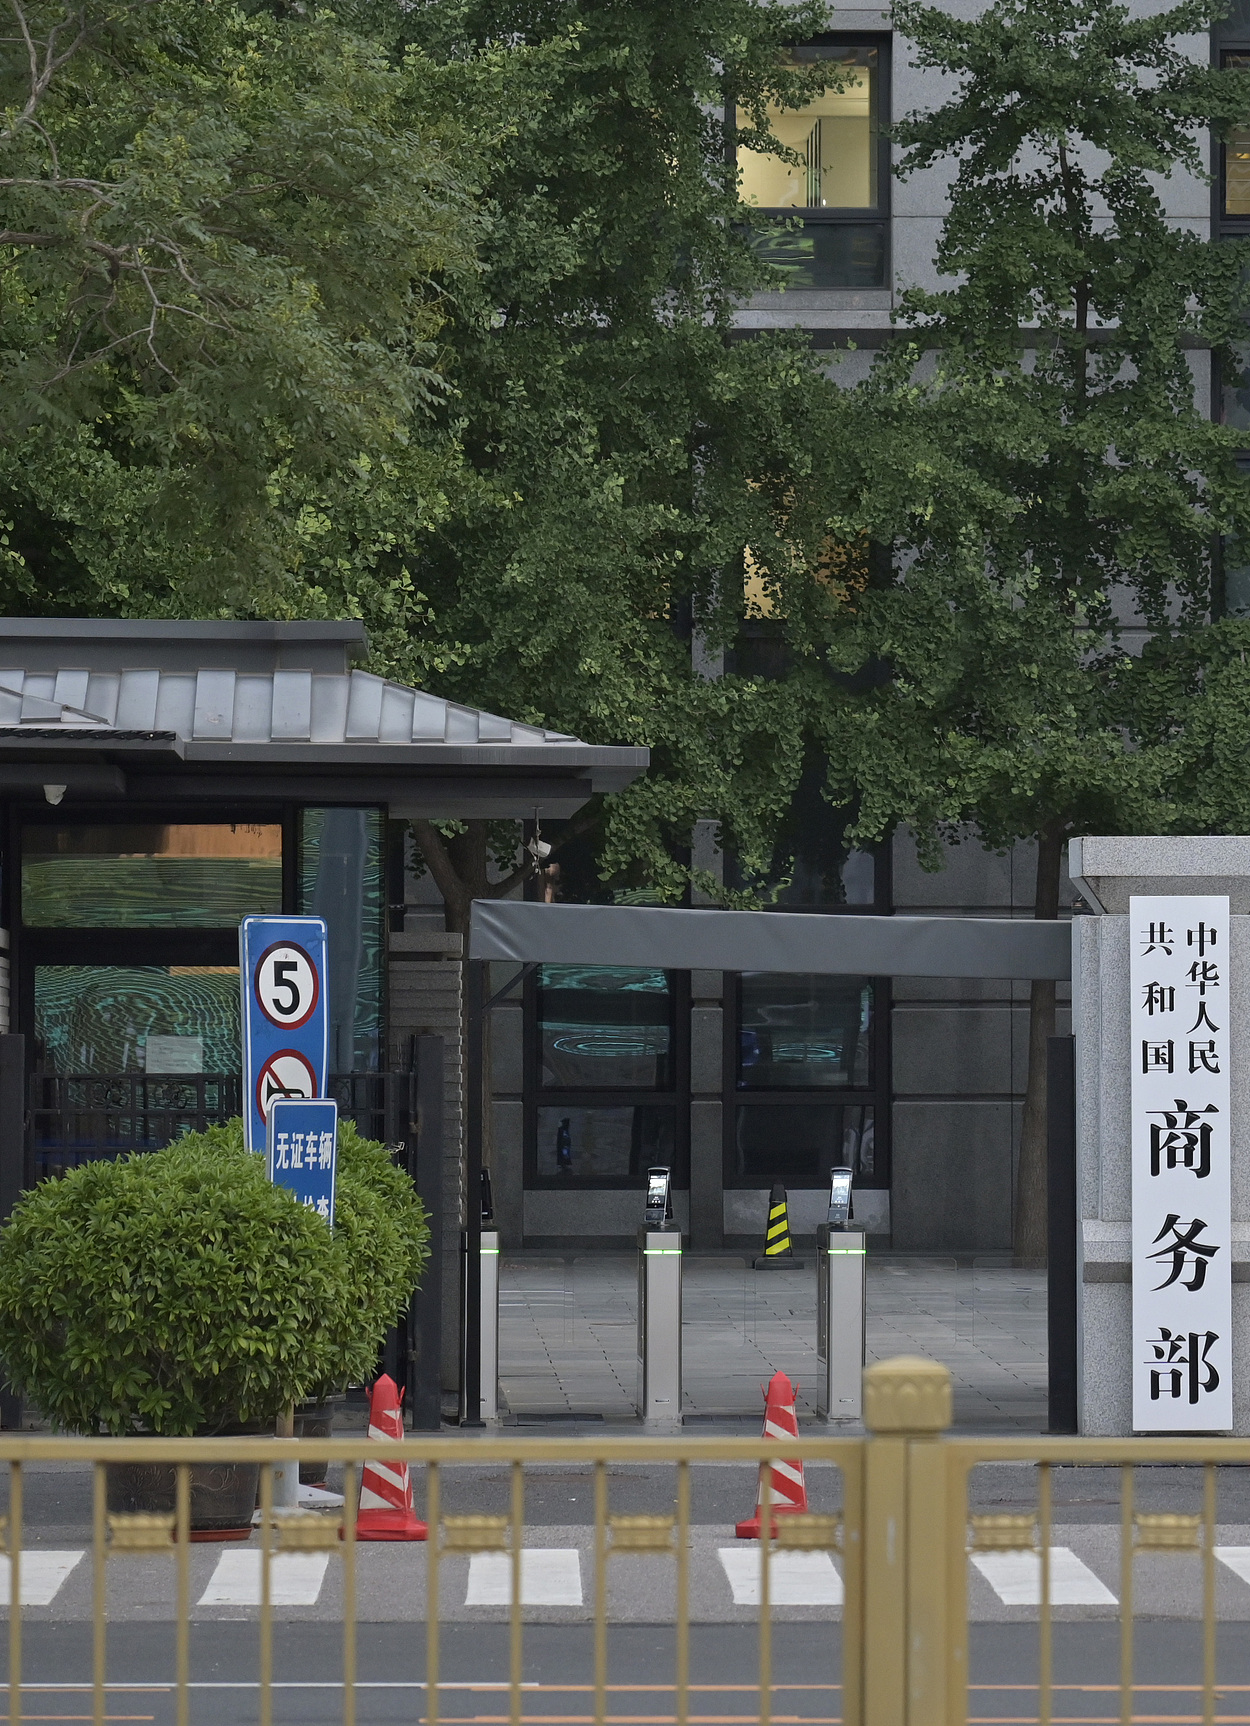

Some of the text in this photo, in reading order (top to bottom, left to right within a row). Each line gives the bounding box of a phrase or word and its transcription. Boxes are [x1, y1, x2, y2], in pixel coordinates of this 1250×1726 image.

[272, 960, 300, 1016] 5
[1140, 921, 1176, 1075] 共和国
[1185, 921, 1221, 1075] 中华人民
[276, 1130, 333, 1170] 无证车辆
[1143, 1098, 1221, 1405] 商务部
